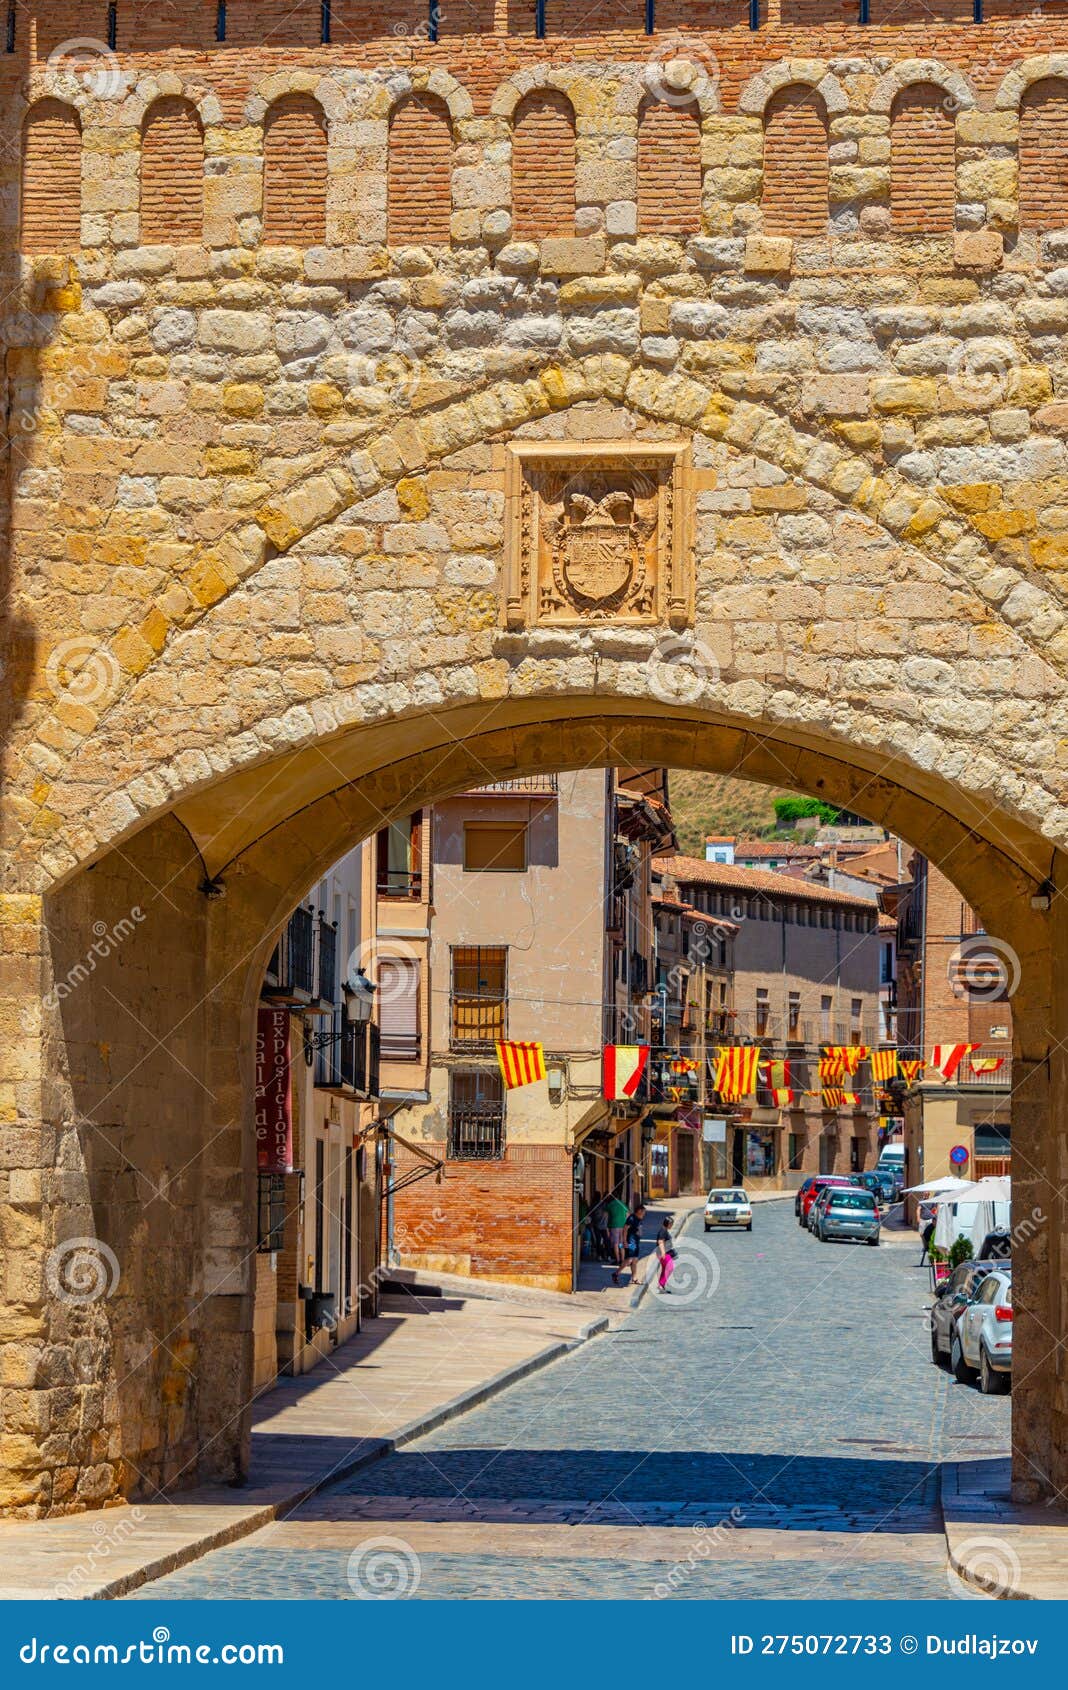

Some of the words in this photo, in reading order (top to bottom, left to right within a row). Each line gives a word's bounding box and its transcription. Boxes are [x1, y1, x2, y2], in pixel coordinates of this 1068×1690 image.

[255, 1032, 266, 1097] Sala
[273, 1011, 286, 1168] Exposiciones
[255, 1109, 268, 1140] de
